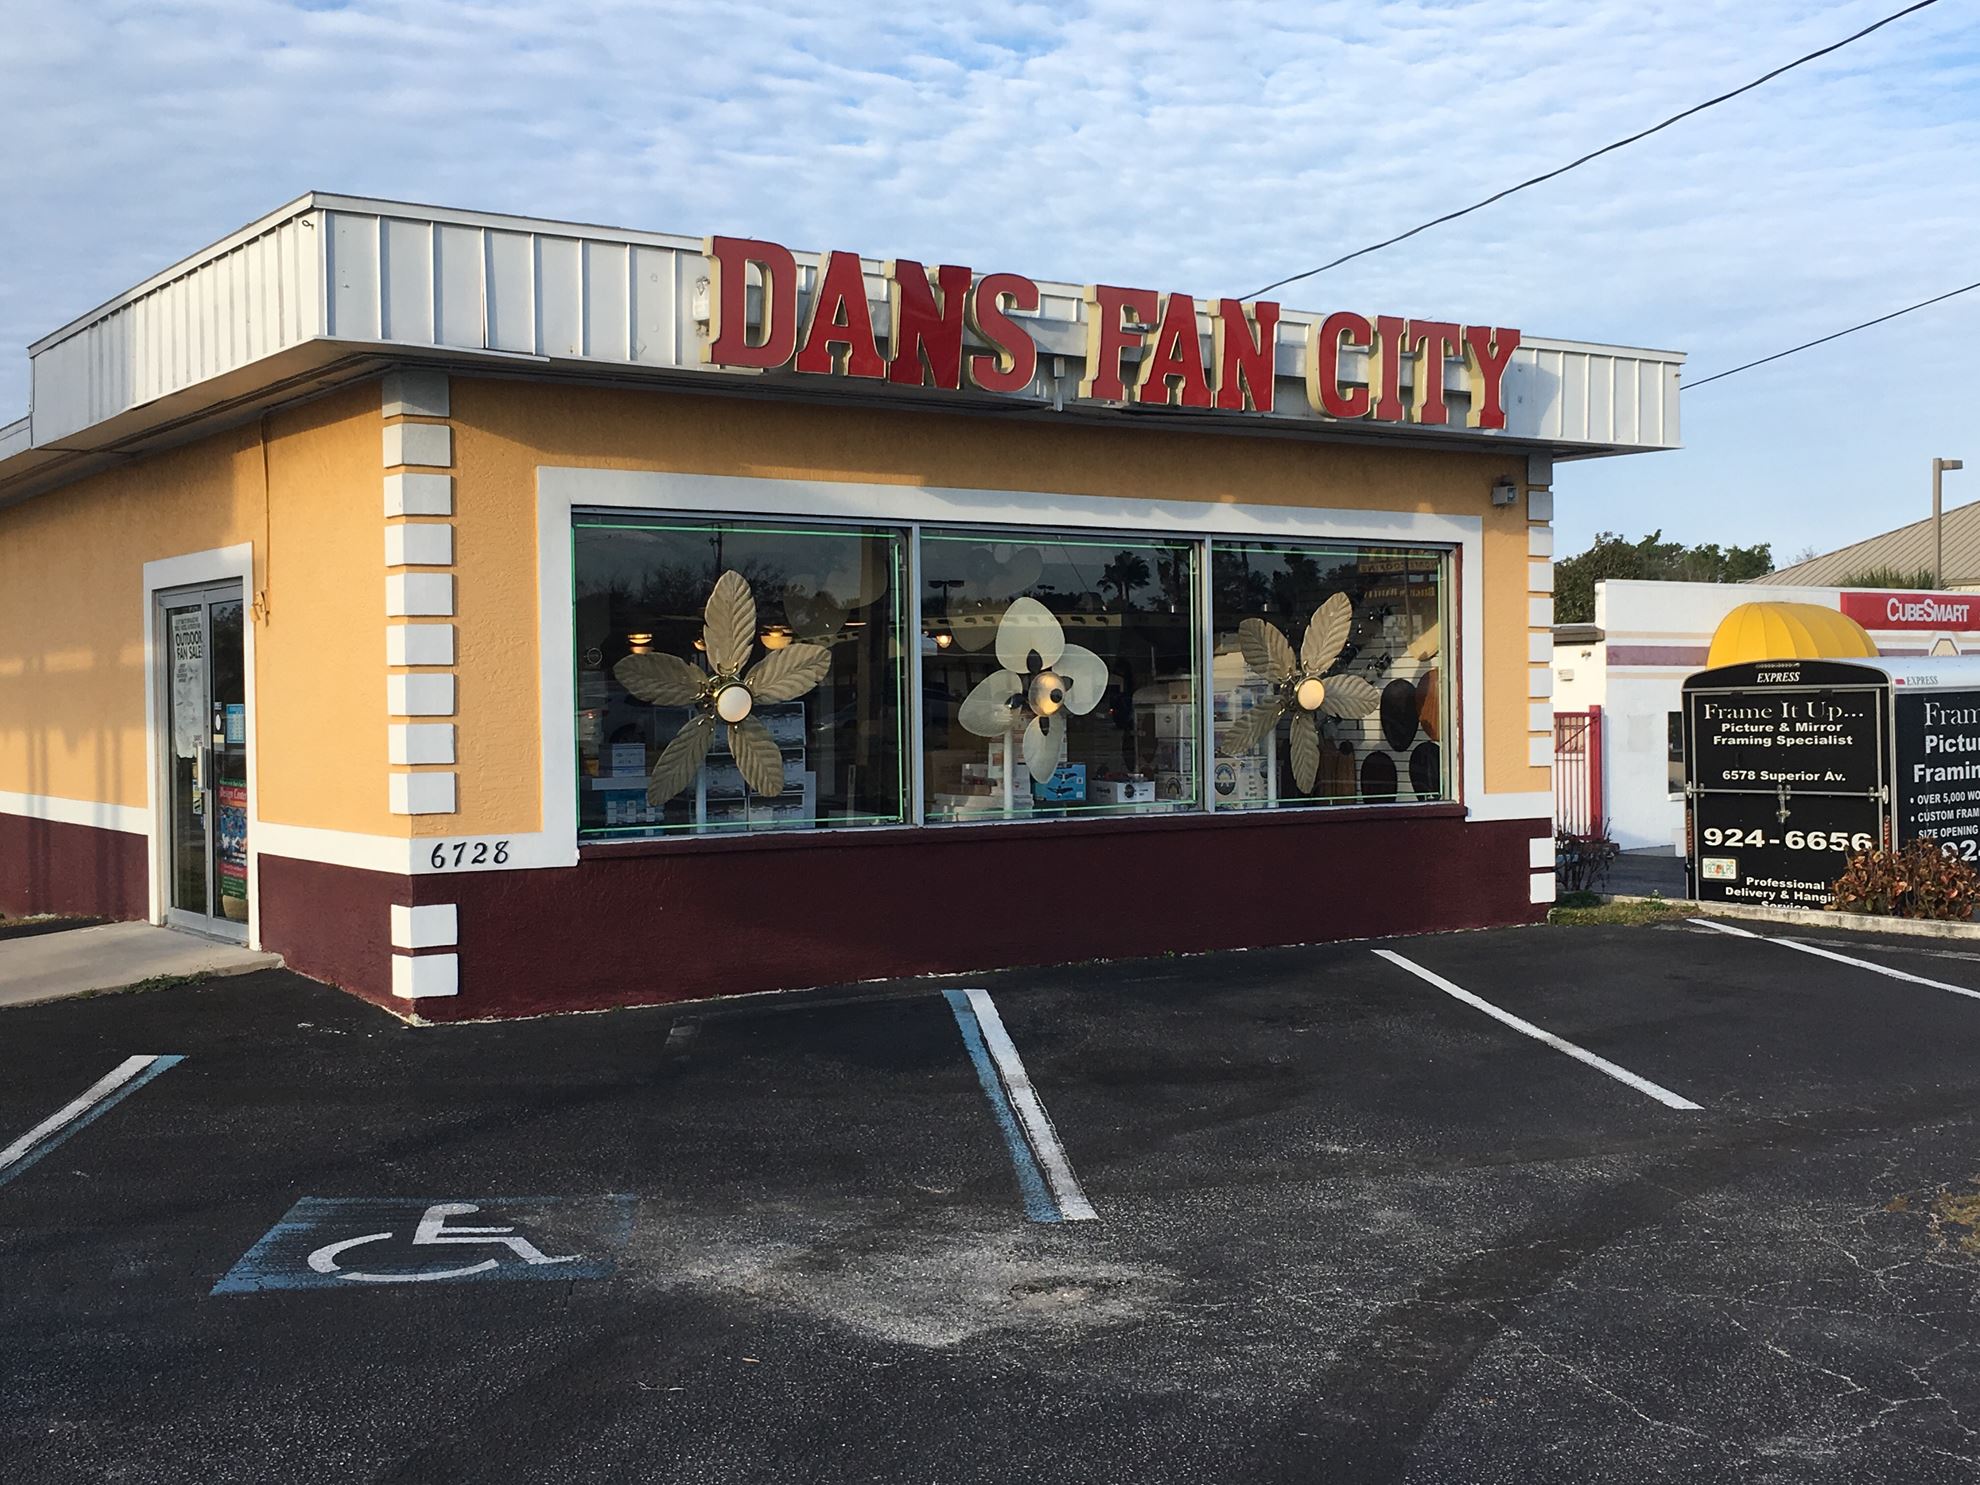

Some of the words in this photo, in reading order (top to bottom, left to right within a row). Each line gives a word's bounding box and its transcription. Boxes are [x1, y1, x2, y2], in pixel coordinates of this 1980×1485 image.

[702, 235, 1041, 393] DANS
[1079, 284, 1280, 413] FAN
[1306, 311, 1521, 430] CITY
[1886, 597, 1970, 622] CUBESMART
[1757, 671, 1801, 683] EXPRESS
[1906, 676, 1939, 686] EXPRESS
[1704, 703, 1773, 720] Frame
[1780, 700, 1798, 718] It
[1721, 723, 1775, 733] Picture
[1779, 723, 1790, 732] &
[1795, 723, 1843, 733] Mirror
[1713, 736, 1772, 747] Framing
[1776, 735, 1853, 747] Specialist
[1925, 734, 1980, 754] Pictu
[1722, 770, 1756, 780] 6578
[1760, 771, 1820, 782] Superior
[1824, 771, 1846, 782] Av.
[1917, 793, 1941, 805] OVER
[1943, 791, 1966, 804] 5,000
[1918, 809, 1954, 822] CUSTOM
[1918, 828, 1939, 838] SIZE
[1940, 825, 1979, 838] OPENING
[1703, 828, 1873, 851] 924-6656
[431, 840, 509, 869] 6728
[1746, 877, 1825, 890] Professional
[1725, 887, 1776, 900] Delivery
[1780, 890, 1790, 899] &
